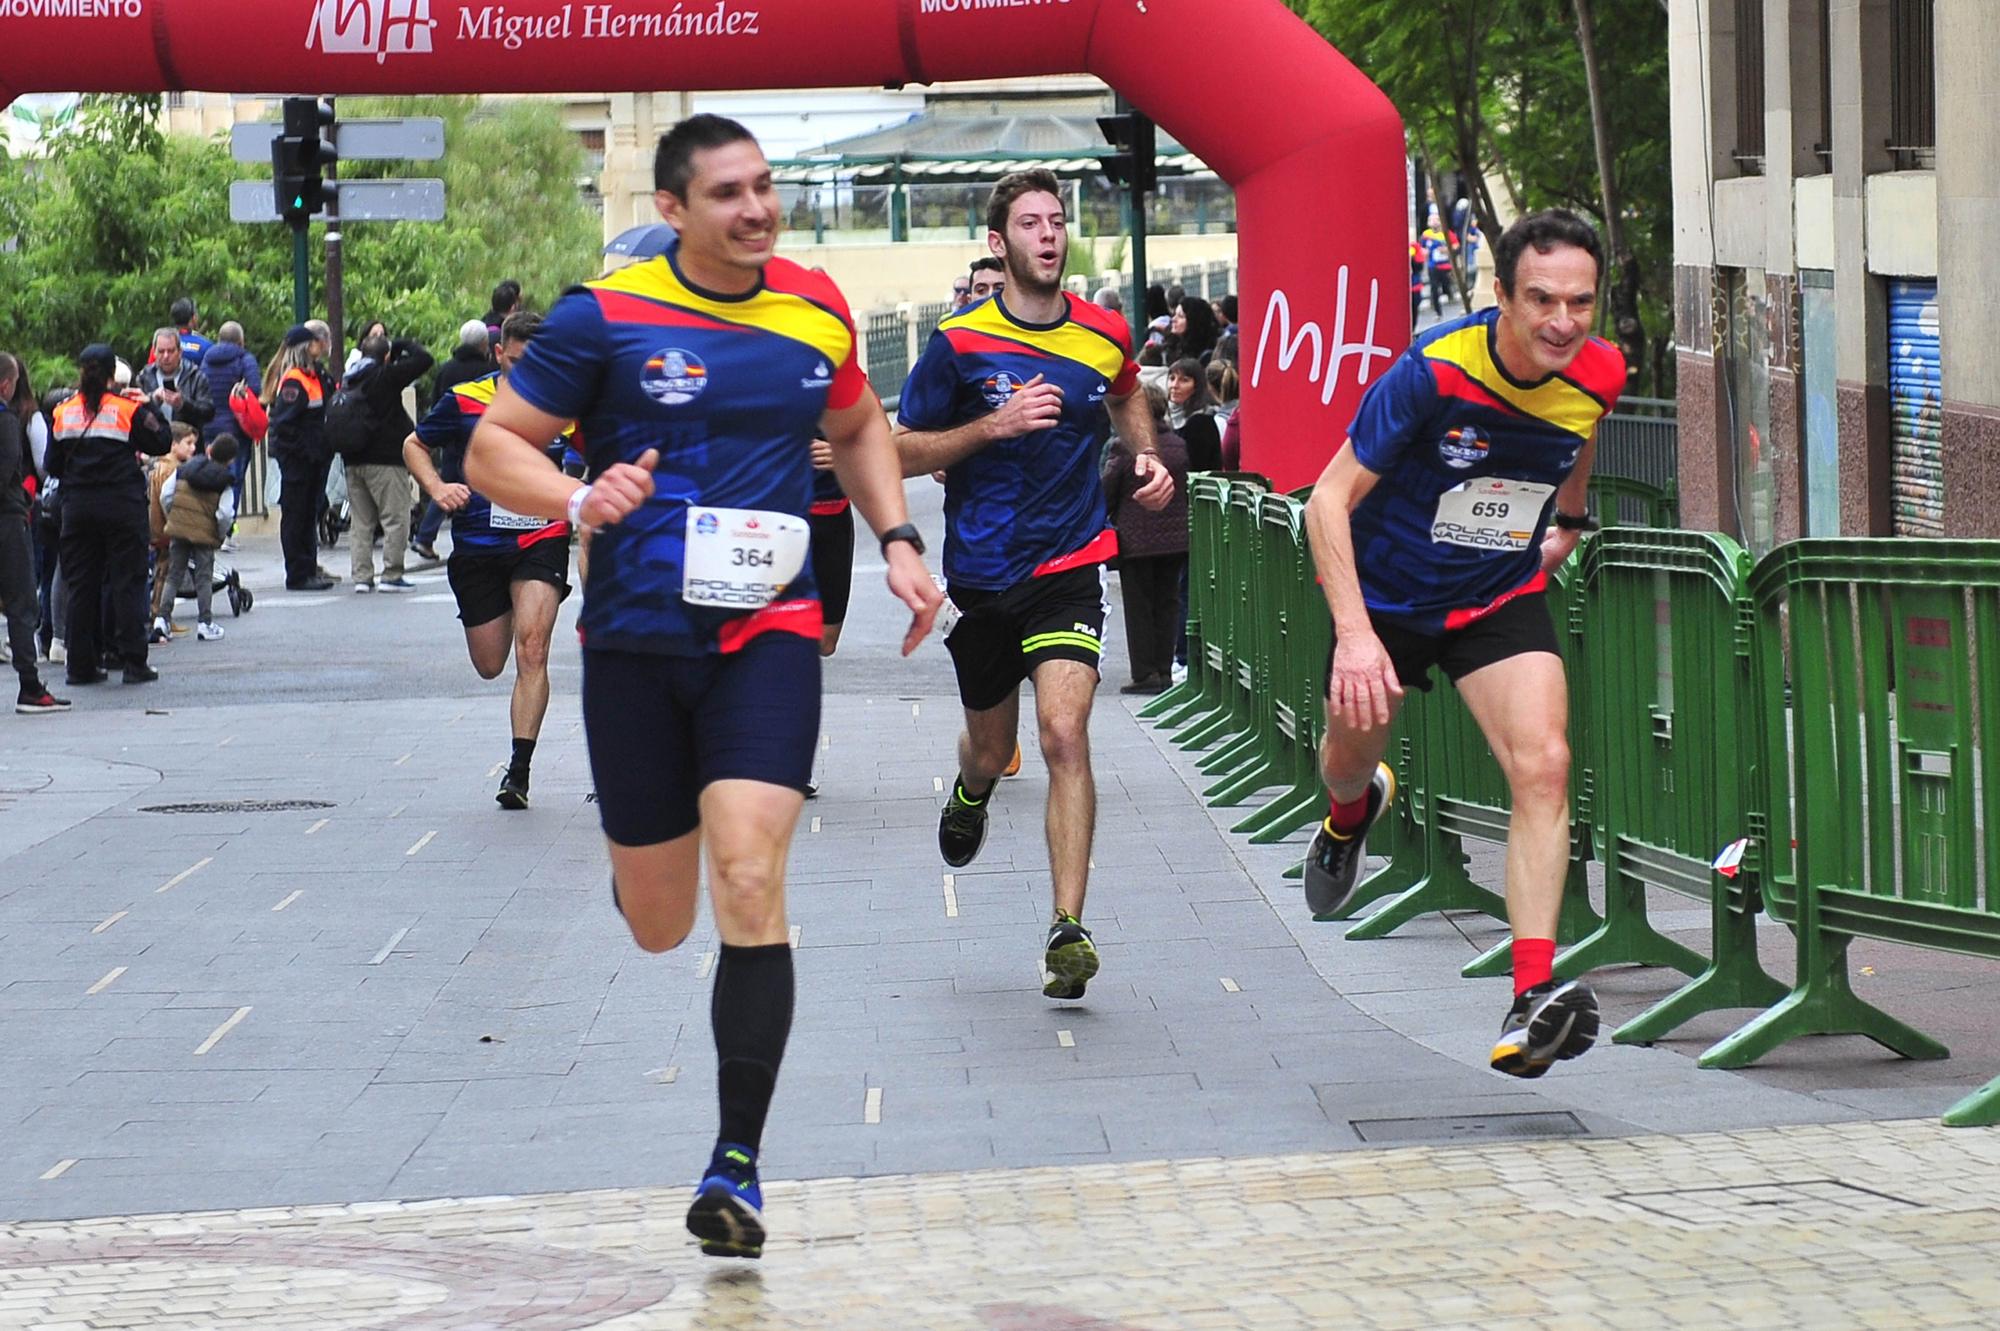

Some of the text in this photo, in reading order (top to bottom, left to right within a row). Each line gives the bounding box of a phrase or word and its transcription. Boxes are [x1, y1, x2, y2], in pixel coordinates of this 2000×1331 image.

[456, 2, 760, 50] Miguel Hernández
[1472, 501, 1509, 518] 659
[1433, 522, 1511, 539] POLICIA
[1432, 531, 1528, 549] NACIONAL
[731, 547, 774, 567] 364
[688, 578, 778, 593] POLICIA
[1073, 622, 1098, 637] FILA
